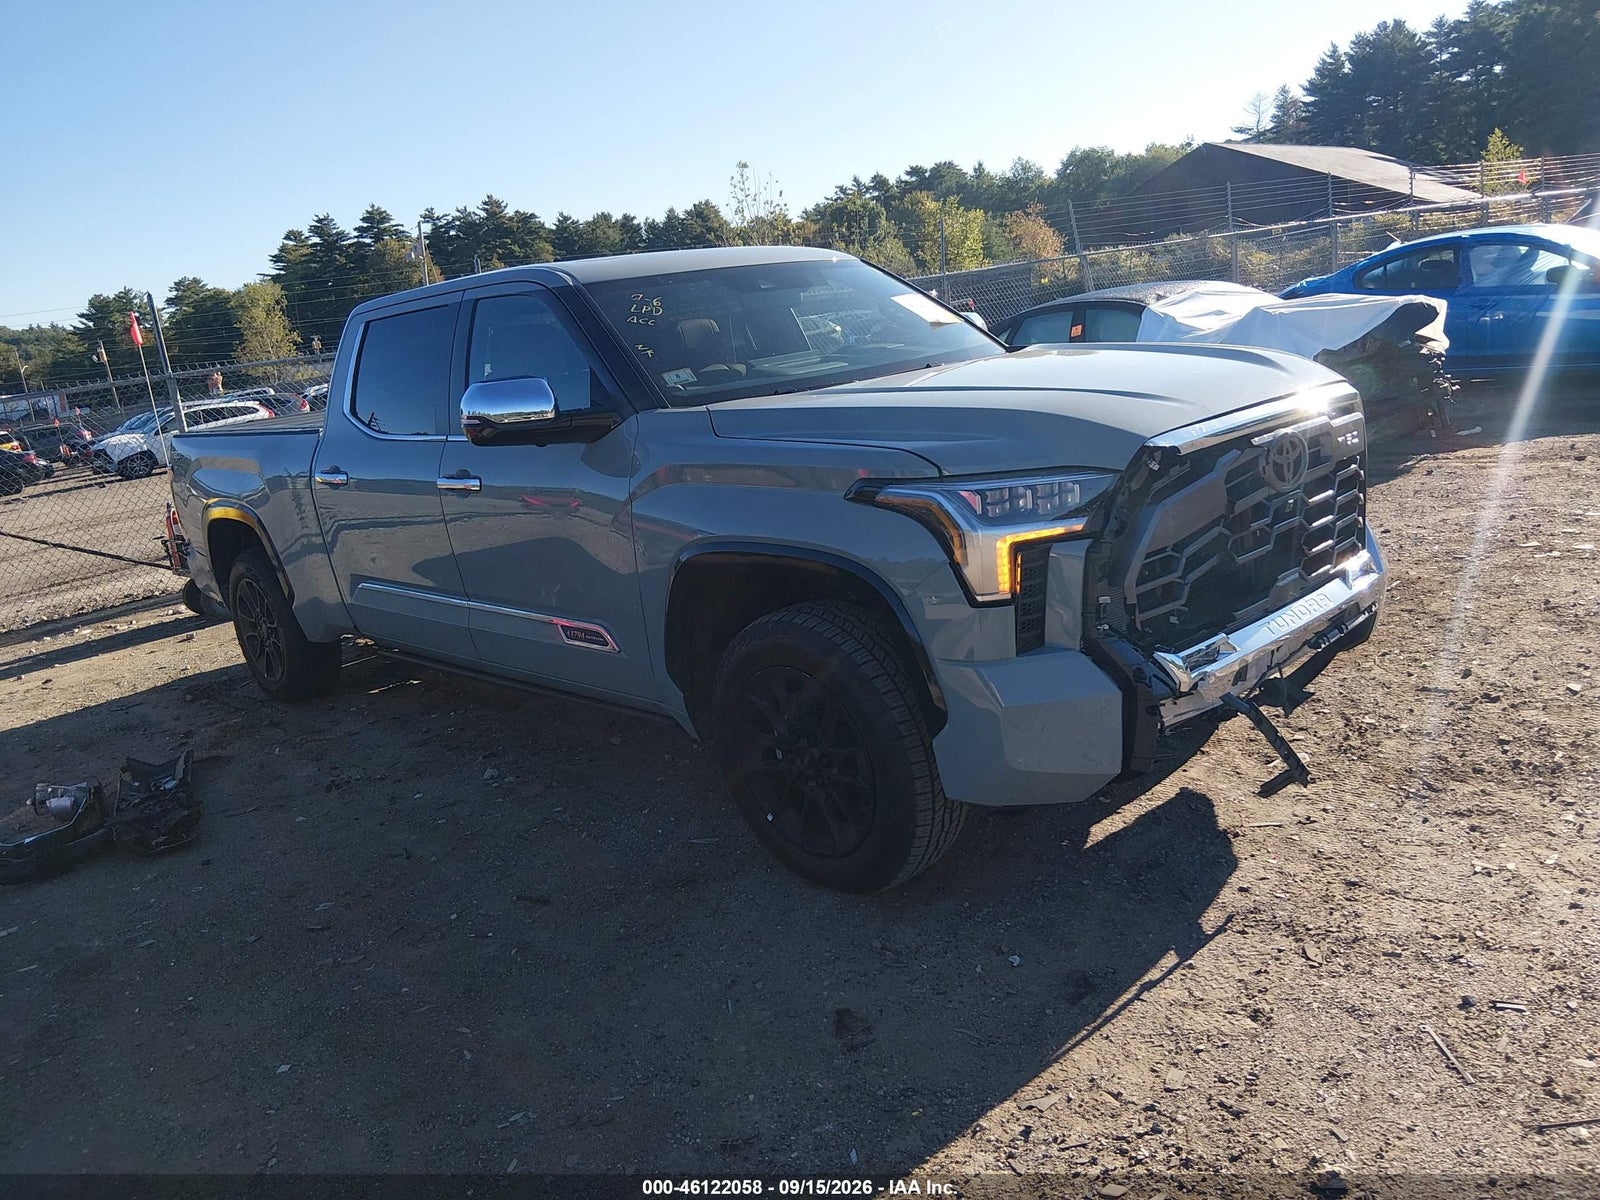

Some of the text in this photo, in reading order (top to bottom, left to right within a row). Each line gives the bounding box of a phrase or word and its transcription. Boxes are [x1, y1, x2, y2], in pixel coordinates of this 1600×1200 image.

[630, 304, 663, 316] LPD
[627, 316, 656, 326] ACC
[1257, 592, 1334, 635] TUNDRA
